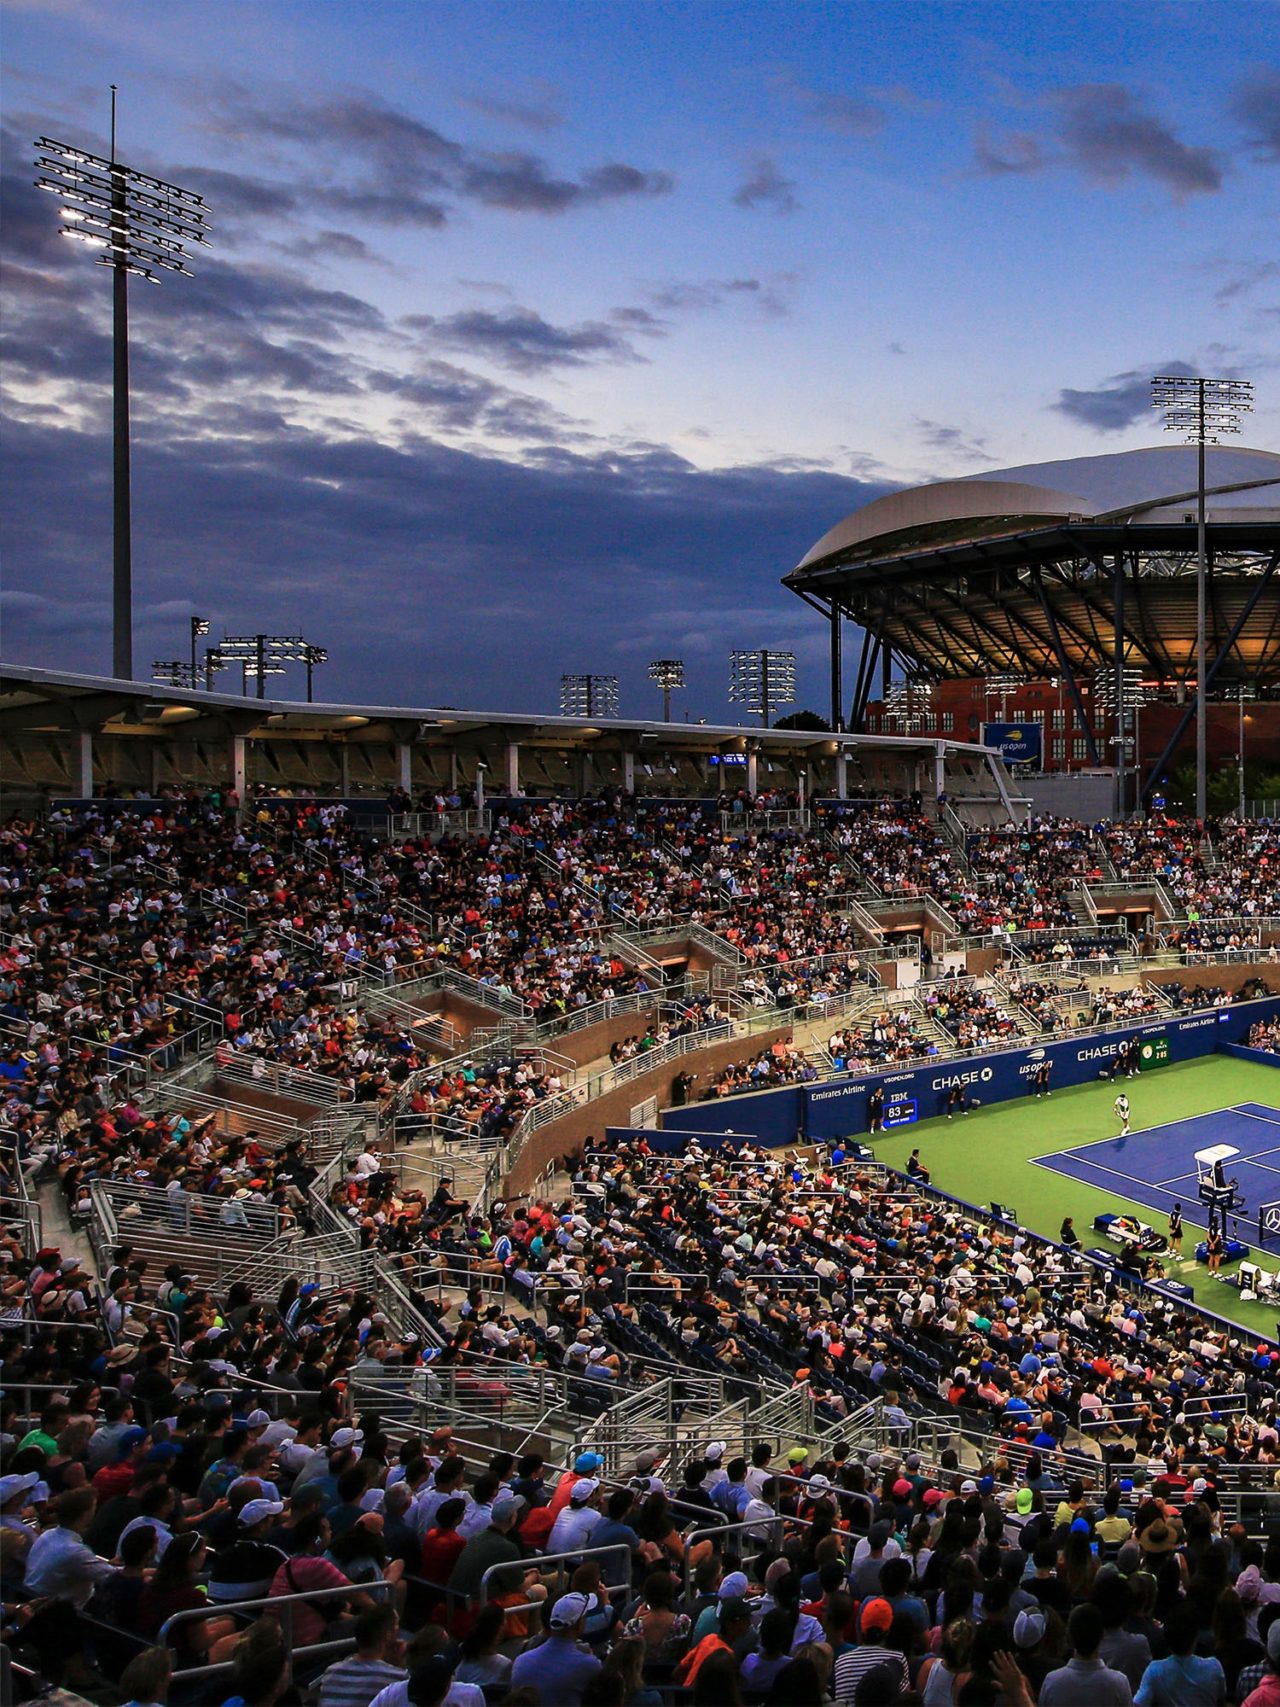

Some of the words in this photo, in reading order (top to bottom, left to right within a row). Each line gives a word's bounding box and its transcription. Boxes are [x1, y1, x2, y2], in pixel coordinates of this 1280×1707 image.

[1008, 743, 1027, 751] open
[1179, 1021, 1200, 1031] Emirates
[1200, 1017, 1216, 1026] Airline
[1077, 1044, 1117, 1061] CHASE
[1019, 1064, 1030, 1075] us
[932, 1071, 979, 1090] CHASE
[811, 1089, 842, 1102] Emirates
[842, 1085, 866, 1096] Airline
[890, 1091, 909, 1103] IBM
[888, 1106, 901, 1118] 83
